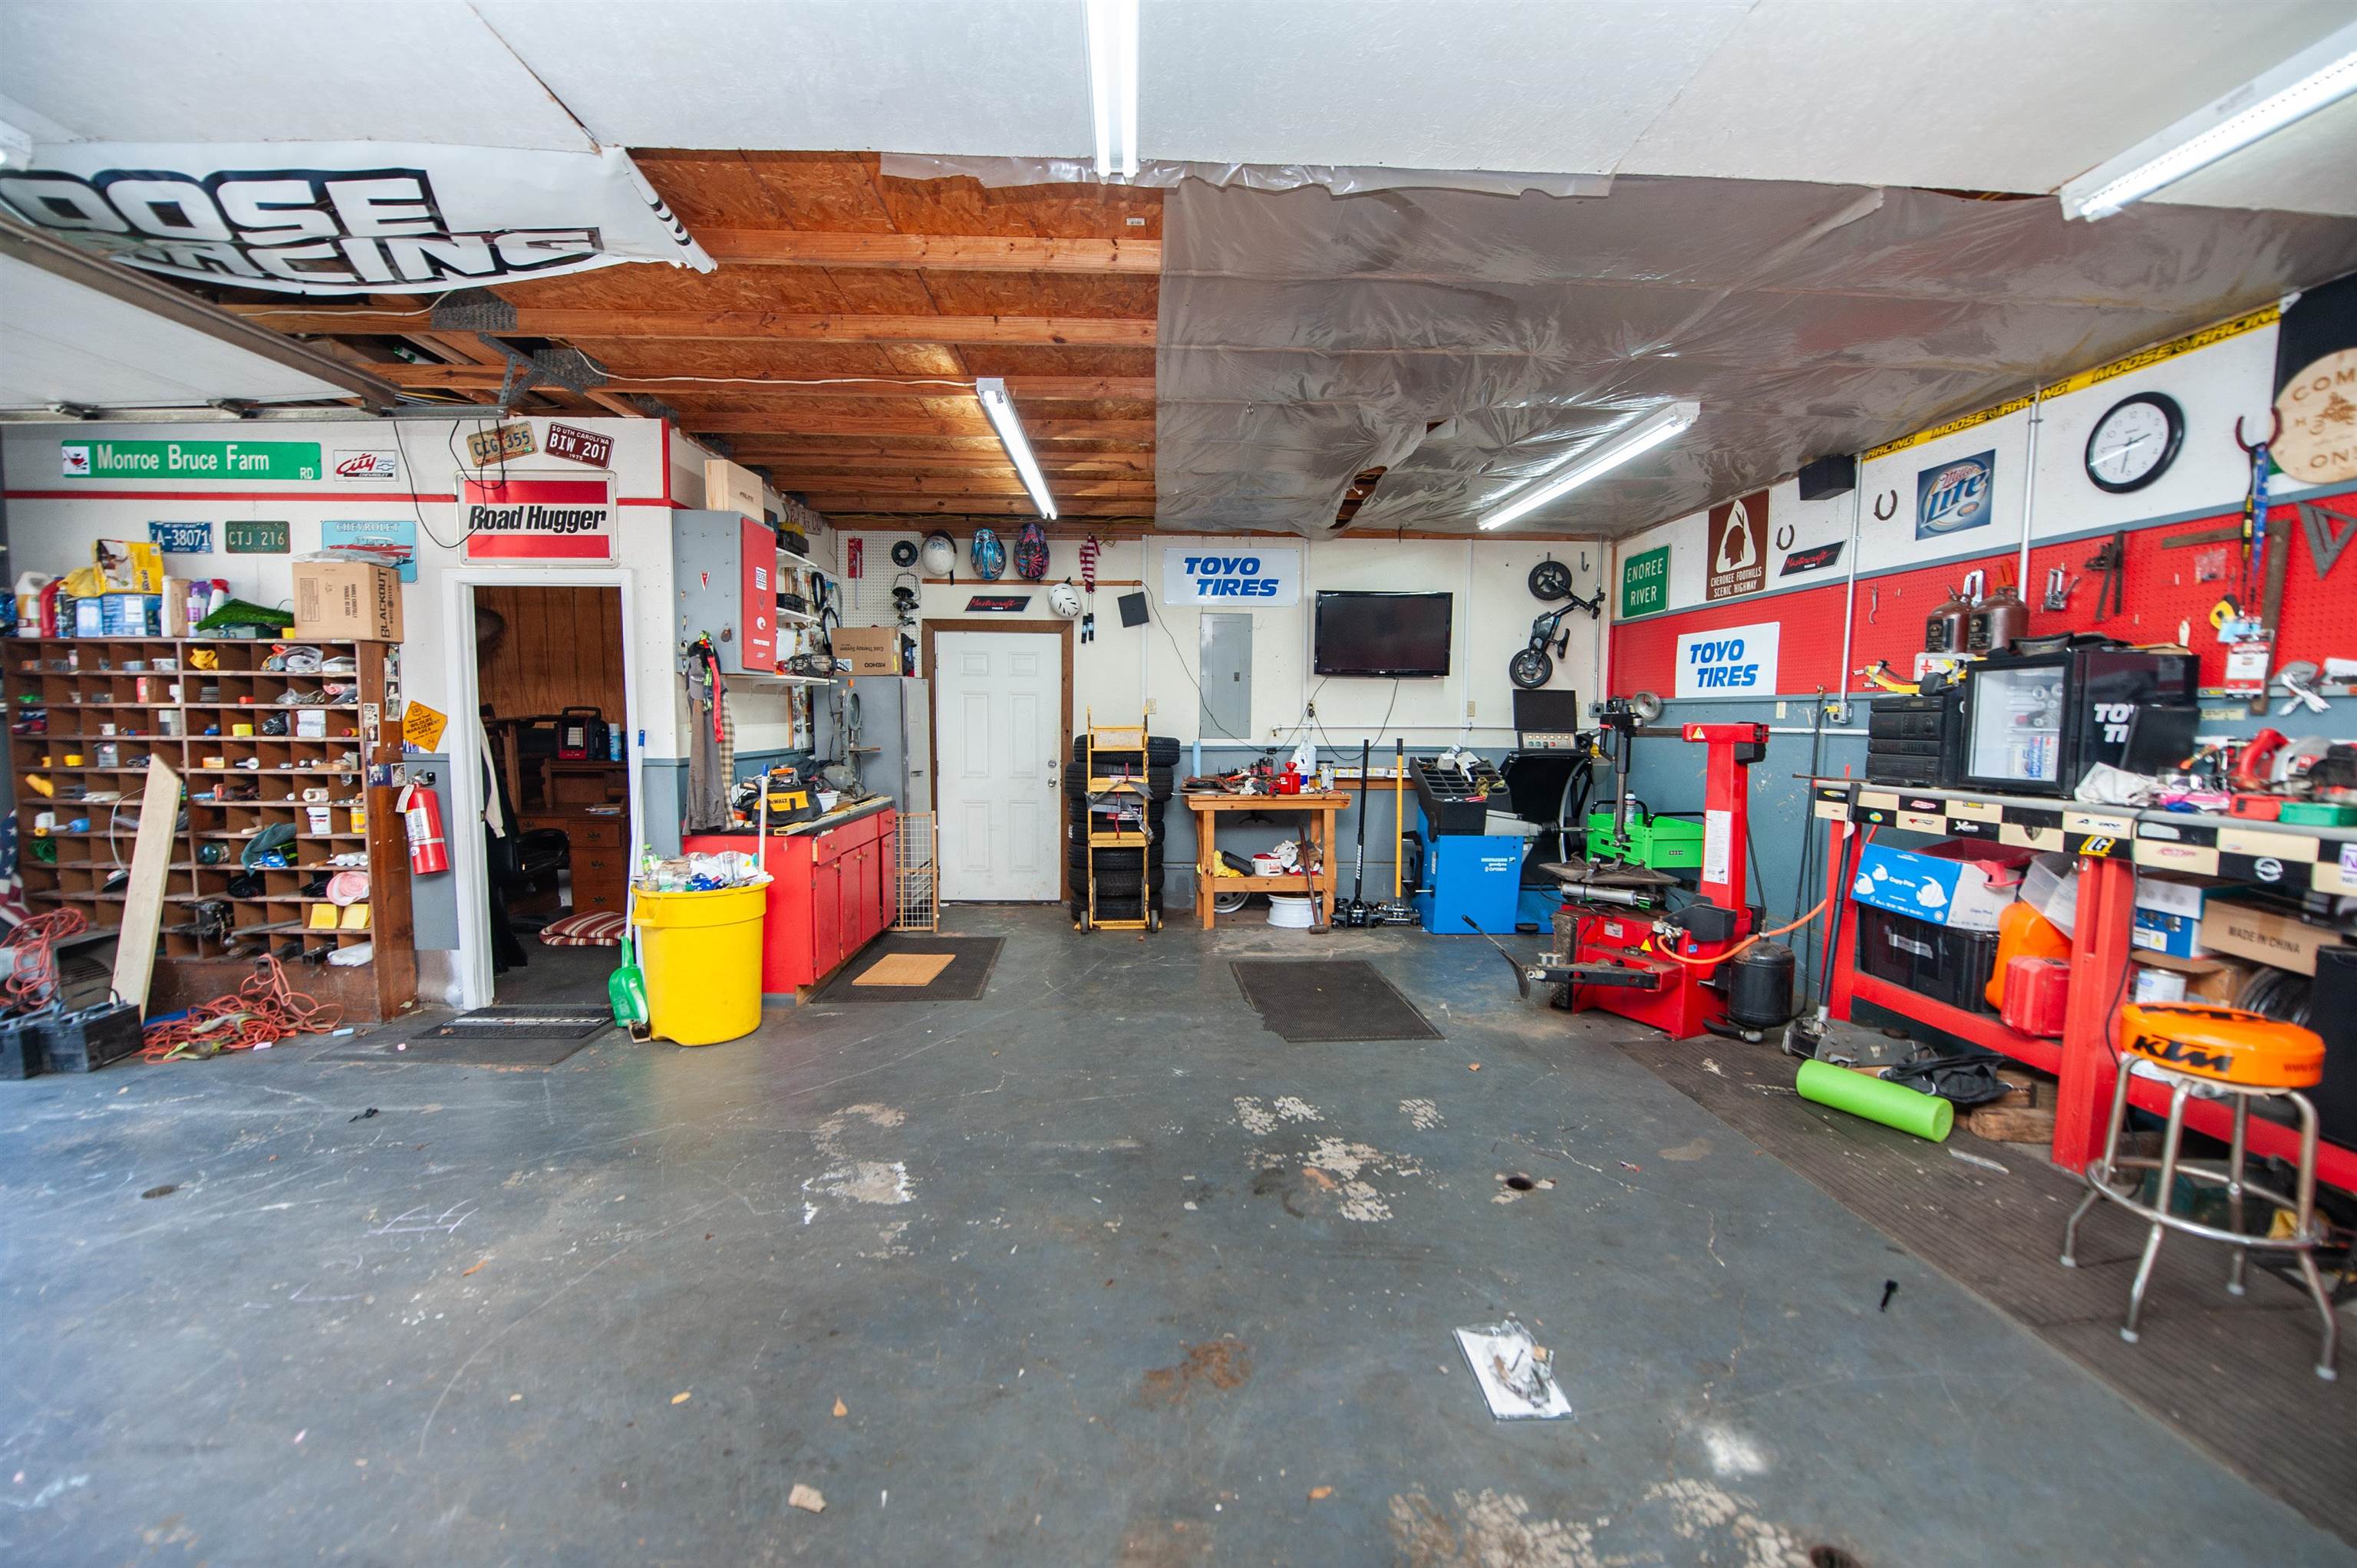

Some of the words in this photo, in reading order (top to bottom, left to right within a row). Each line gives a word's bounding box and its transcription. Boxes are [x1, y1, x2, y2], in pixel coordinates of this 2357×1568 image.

[0, 170, 447, 247] OOSE
[2091, 344, 2171, 383] MOOSE
[2191, 308, 2282, 353] RACIN
[2293, 367, 2356, 402] COM
[1930, 412, 1986, 440] MOOSE
[1999, 383, 2069, 414] RACNG
[506, 430, 530, 449] 355
[549, 433, 576, 453] BIW
[582, 442, 607, 461] 201
[576, 432, 609, 446] CAROLINA
[97, 445, 160, 470] Monroe
[168, 444, 218, 471] Bruce
[226, 445, 270, 471] Farm
[300, 466, 314, 480] RD
[1940, 466, 1977, 489] Miller
[337, 522, 400, 532] CHEVROLET
[469, 506, 524, 530] Road
[526, 506, 607, 534] Hugger
[157, 529, 209, 545] A-38071
[228, 532, 252, 545] CTJ
[261, 532, 285, 545] 216
[1184, 557, 1261, 575] TOYO
[1627, 558, 1663, 583] ENOREE
[1710, 573, 1735, 588] CHEROKEE
[1736, 566, 1762, 582] FOOTHILLS
[1196, 578, 1279, 597] TIRES
[1630, 585, 1657, 606] RIVER
[1713, 584, 1732, 598] SCENIC
[1734, 580, 1757, 595] HIGHWAY
[377, 568, 391, 638] BLACKOUT
[1689, 639, 1745, 664] TOYO
[1696, 664, 1759, 688] TIRES
[2094, 703, 2135, 723] TO
[2228, 926, 2255, 942] MADE
[2258, 934, 2268, 945] IN
[2269, 937, 2301, 954] CHINA
[2132, 1034, 2235, 1072] KTM
